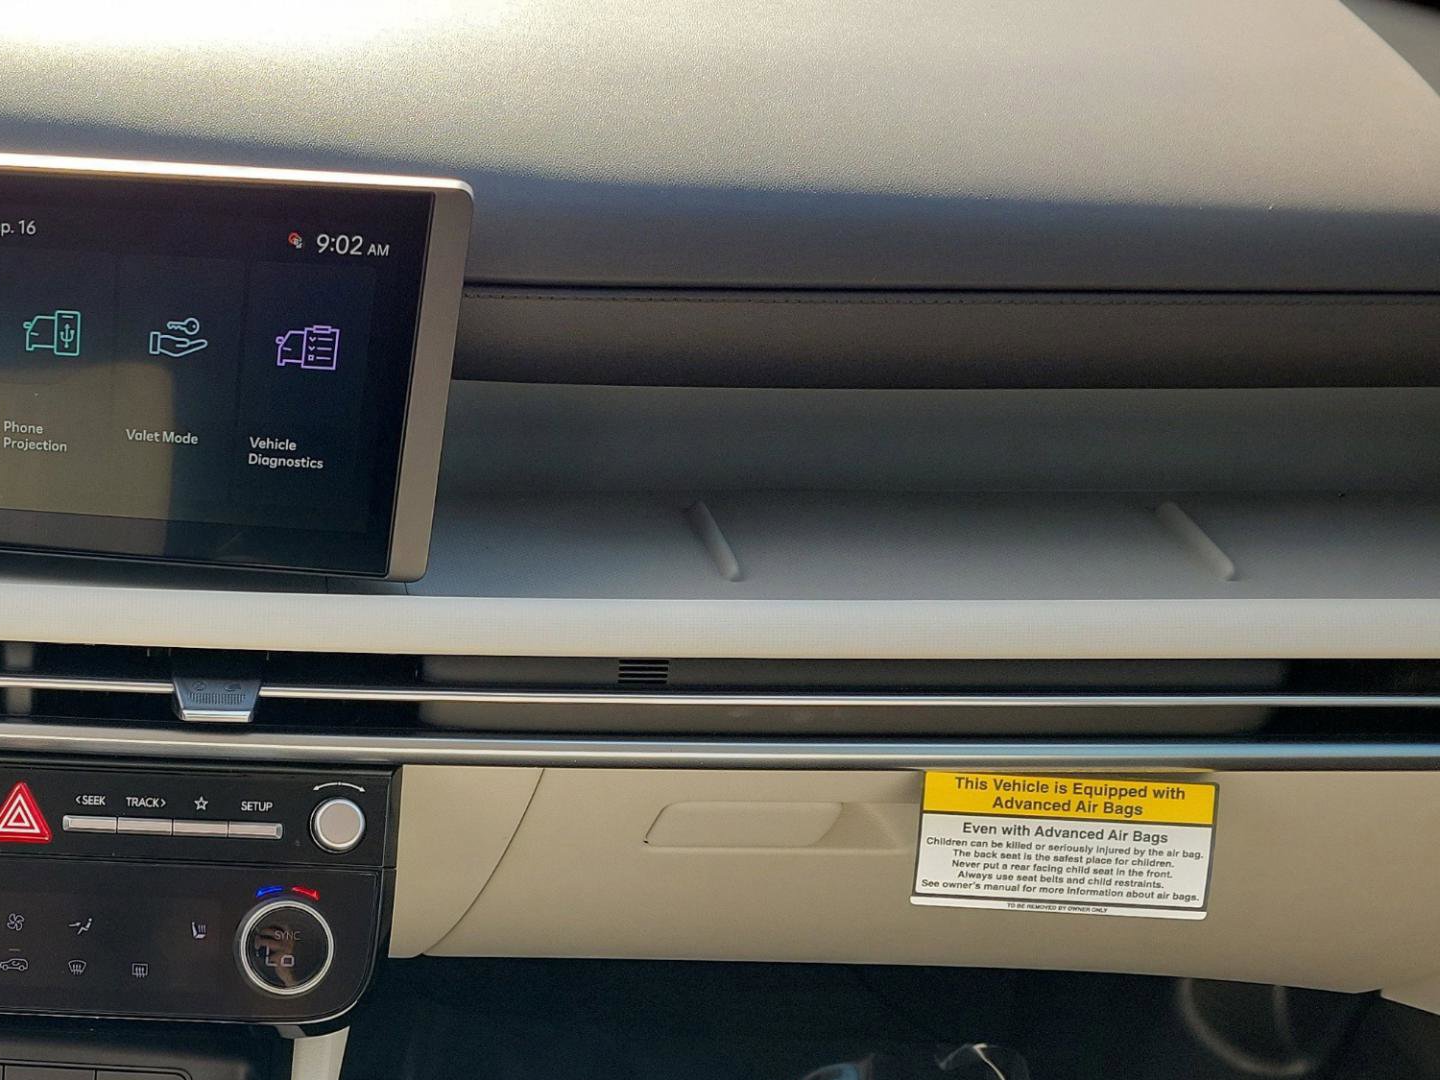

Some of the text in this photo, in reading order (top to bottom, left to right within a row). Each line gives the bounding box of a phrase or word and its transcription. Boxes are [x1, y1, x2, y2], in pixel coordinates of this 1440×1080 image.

[19, 220, 37, 235] 16
[316, 233, 390, 257] 9:02 AM
[3, 420, 44, 434] Phone
[3, 437, 67, 453] Projection
[126, 428, 199, 445] Valet Mode
[249, 436, 297, 451] Vehicle
[248, 453, 324, 470] Diagnostics
[955, 777, 1186, 800] This Vehicle is Equipped with
[241, 801, 273, 813] SETUP
[992, 796, 1143, 818] Advanced Air Bags
[962, 822, 1168, 845] Even with Advanced Air Bags
[926, 837, 1204, 860] Children can be killed or seriously injured by the air bag.
[953, 849, 1175, 868] The back seat is the safest place for children.
[952, 860, 980, 869] Never
[983, 862, 999, 871] put
[1011, 864, 1030, 872] rear
[1033, 863, 1063, 874] facing
[1066, 865, 1090, 874] child
[1093, 867, 1113, 876] seat
[1116, 868, 1125, 876] in
[1128, 868, 1144, 877] the
[1146, 869, 1173, 879] front.
[958, 871, 993, 881] Always
[1016, 874, 1037, 883] seat
[1040, 873, 1064, 883] belts
[1066, 876, 1085, 885] and
[1088, 876, 1112, 887] child
[1114, 878, 1164, 889] restraints.
[921, 879, 940, 888] See
[983, 882, 1019, 893] manual
[1022, 883, 1037, 893] for
[1039, 885, 1064, 894] more
[1067, 886, 1123, 898] information
[1126, 889, 1154, 900] about
[1157, 891, 1169, 900] air
[1172, 891, 1200, 903] bags.
[274, 930, 301, 942] SYNC
